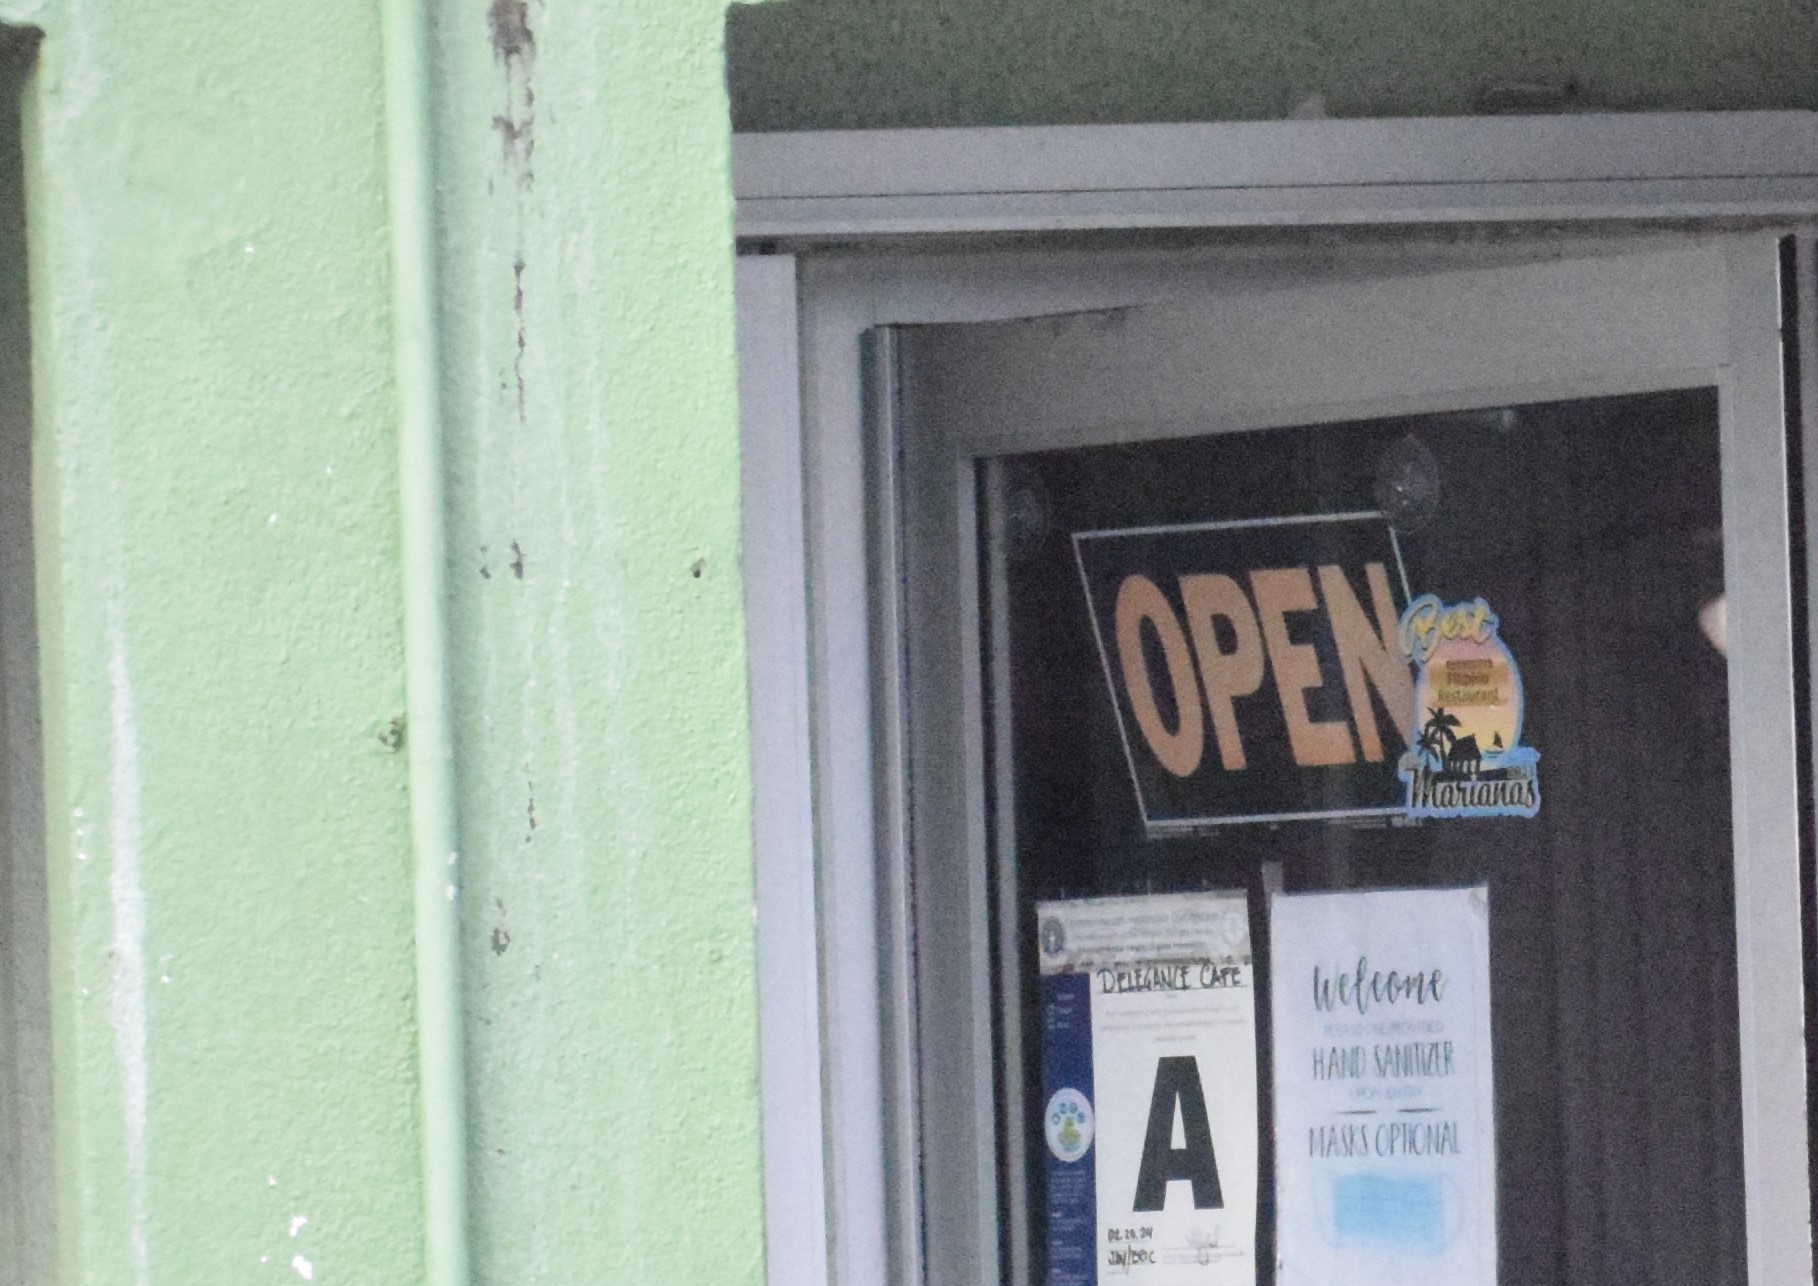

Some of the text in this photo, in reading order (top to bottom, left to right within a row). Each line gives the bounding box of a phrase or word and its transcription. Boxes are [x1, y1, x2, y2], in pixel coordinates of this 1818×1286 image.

[1401, 598, 1494, 663] Best
[1115, 562, 1418, 778] OPEN
[1410, 766, 1533, 808] Marianas
[1199, 959, 1242, 989] CAFE
[1313, 956, 1449, 1015] Welcome
[1313, 1040, 1455, 1080] HAND SANITIZER
[1133, 1055, 1224, 1212] A
[1309, 1120, 1461, 1158] MASKS OPTIONAL
